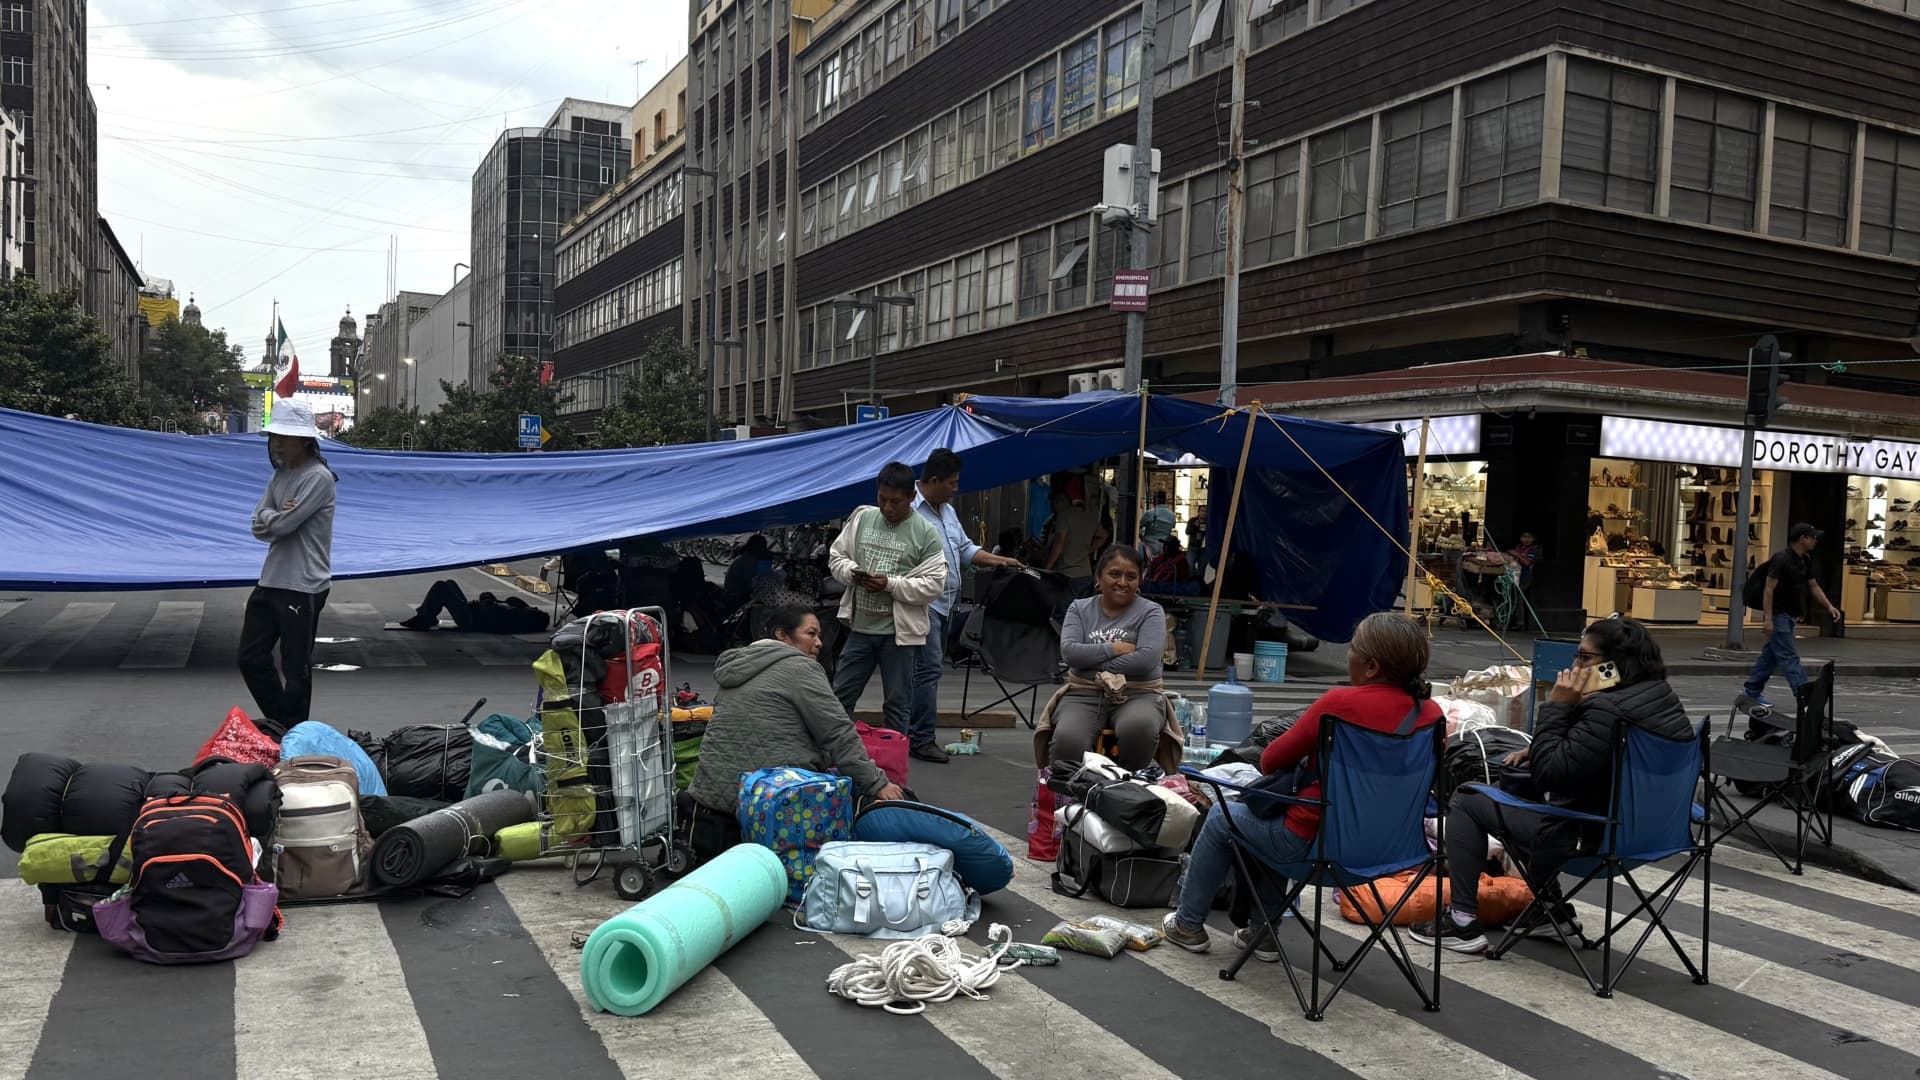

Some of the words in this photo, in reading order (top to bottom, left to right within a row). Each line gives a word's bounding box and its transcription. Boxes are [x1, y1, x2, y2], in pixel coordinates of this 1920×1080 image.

[1753, 439, 1865, 468] DOROTHY
[1875, 448, 1918, 472] GAY
[642, 672, 652, 688] B
